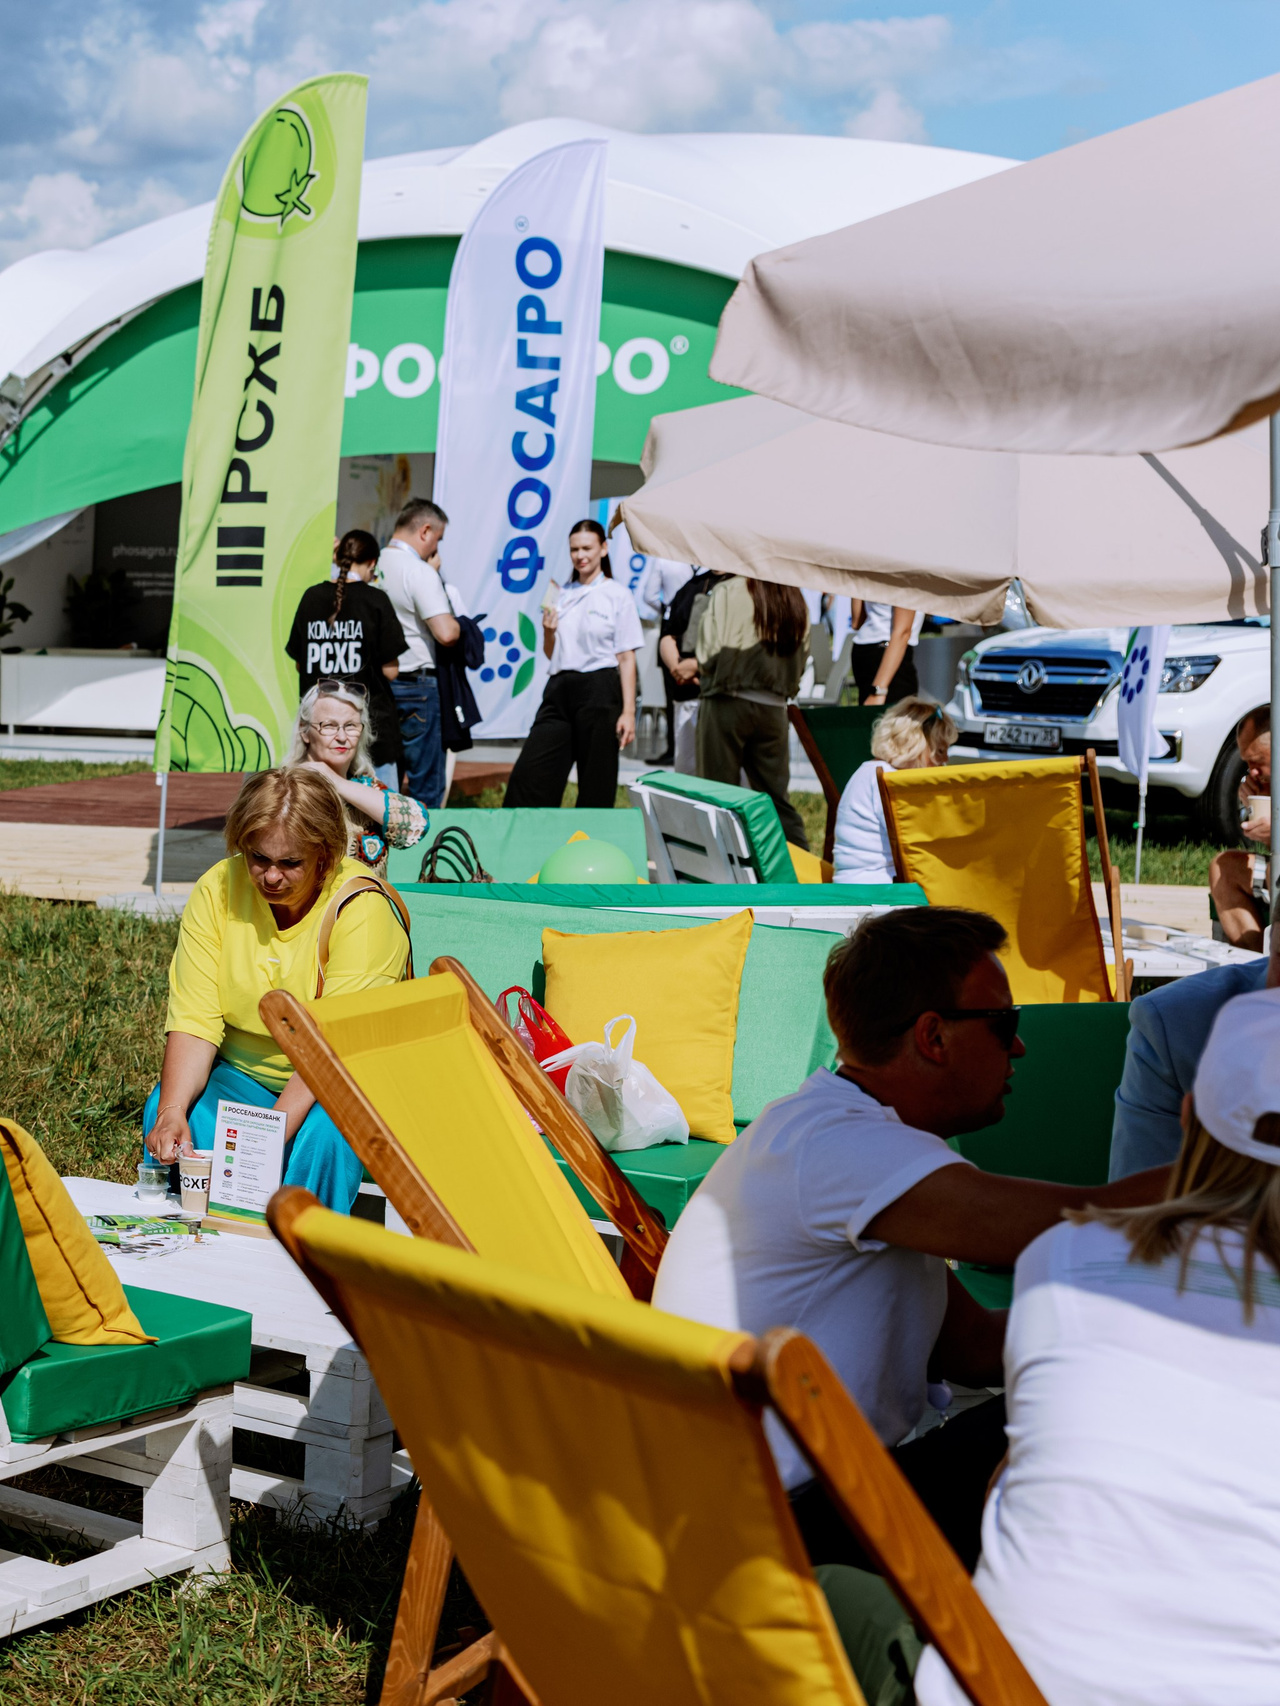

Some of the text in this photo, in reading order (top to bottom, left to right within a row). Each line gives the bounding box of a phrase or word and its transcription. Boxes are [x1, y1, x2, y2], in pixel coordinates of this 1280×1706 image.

[220, 284, 285, 504] РСХБ
[497, 236, 563, 594] ФОСАГРО
[112, 542, 178, 559] phosagro.r
[307, 619, 364, 640] КОМАНДА
[306, 641, 363, 675] РСХБ
[227, 1106, 281, 1122] РОССЕЛЬХОЗБАНК
